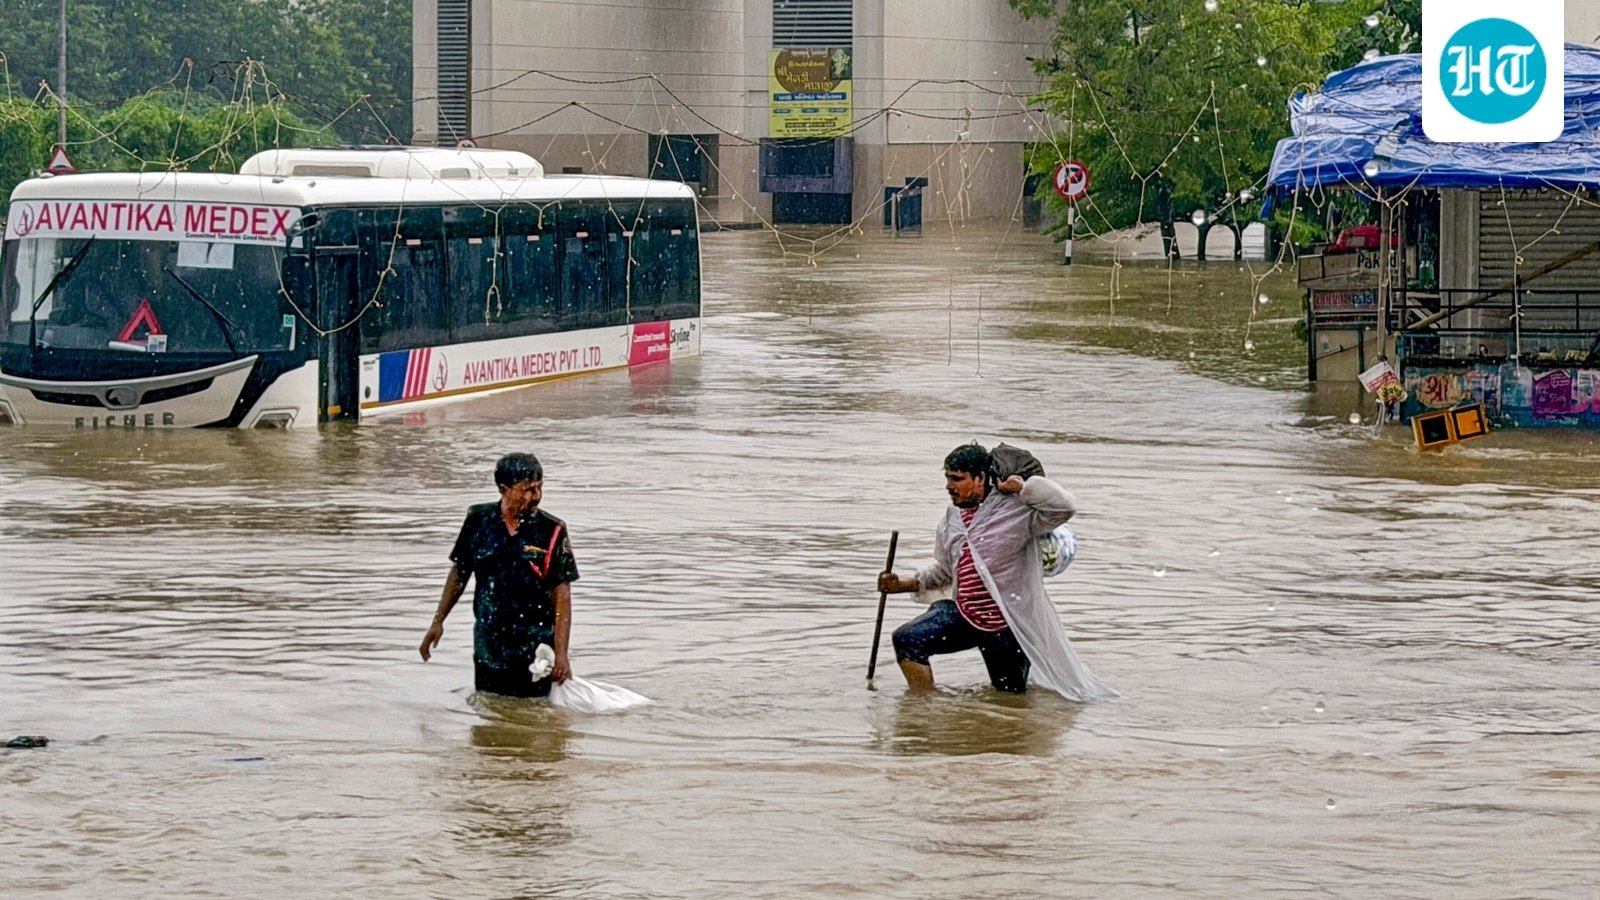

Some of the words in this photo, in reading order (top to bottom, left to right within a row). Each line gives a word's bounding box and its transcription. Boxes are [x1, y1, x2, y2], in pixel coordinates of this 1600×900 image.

[35, 202, 174, 232] AVANTIKA
[184, 204, 291, 237] MEDEX
[670, 327, 690, 347] Skyline
[463, 357, 519, 384] AVANTIKA
[521, 351, 557, 375] MEDEX
[558, 349, 580, 372] PVT.
[583, 345, 604, 369] LTD.
